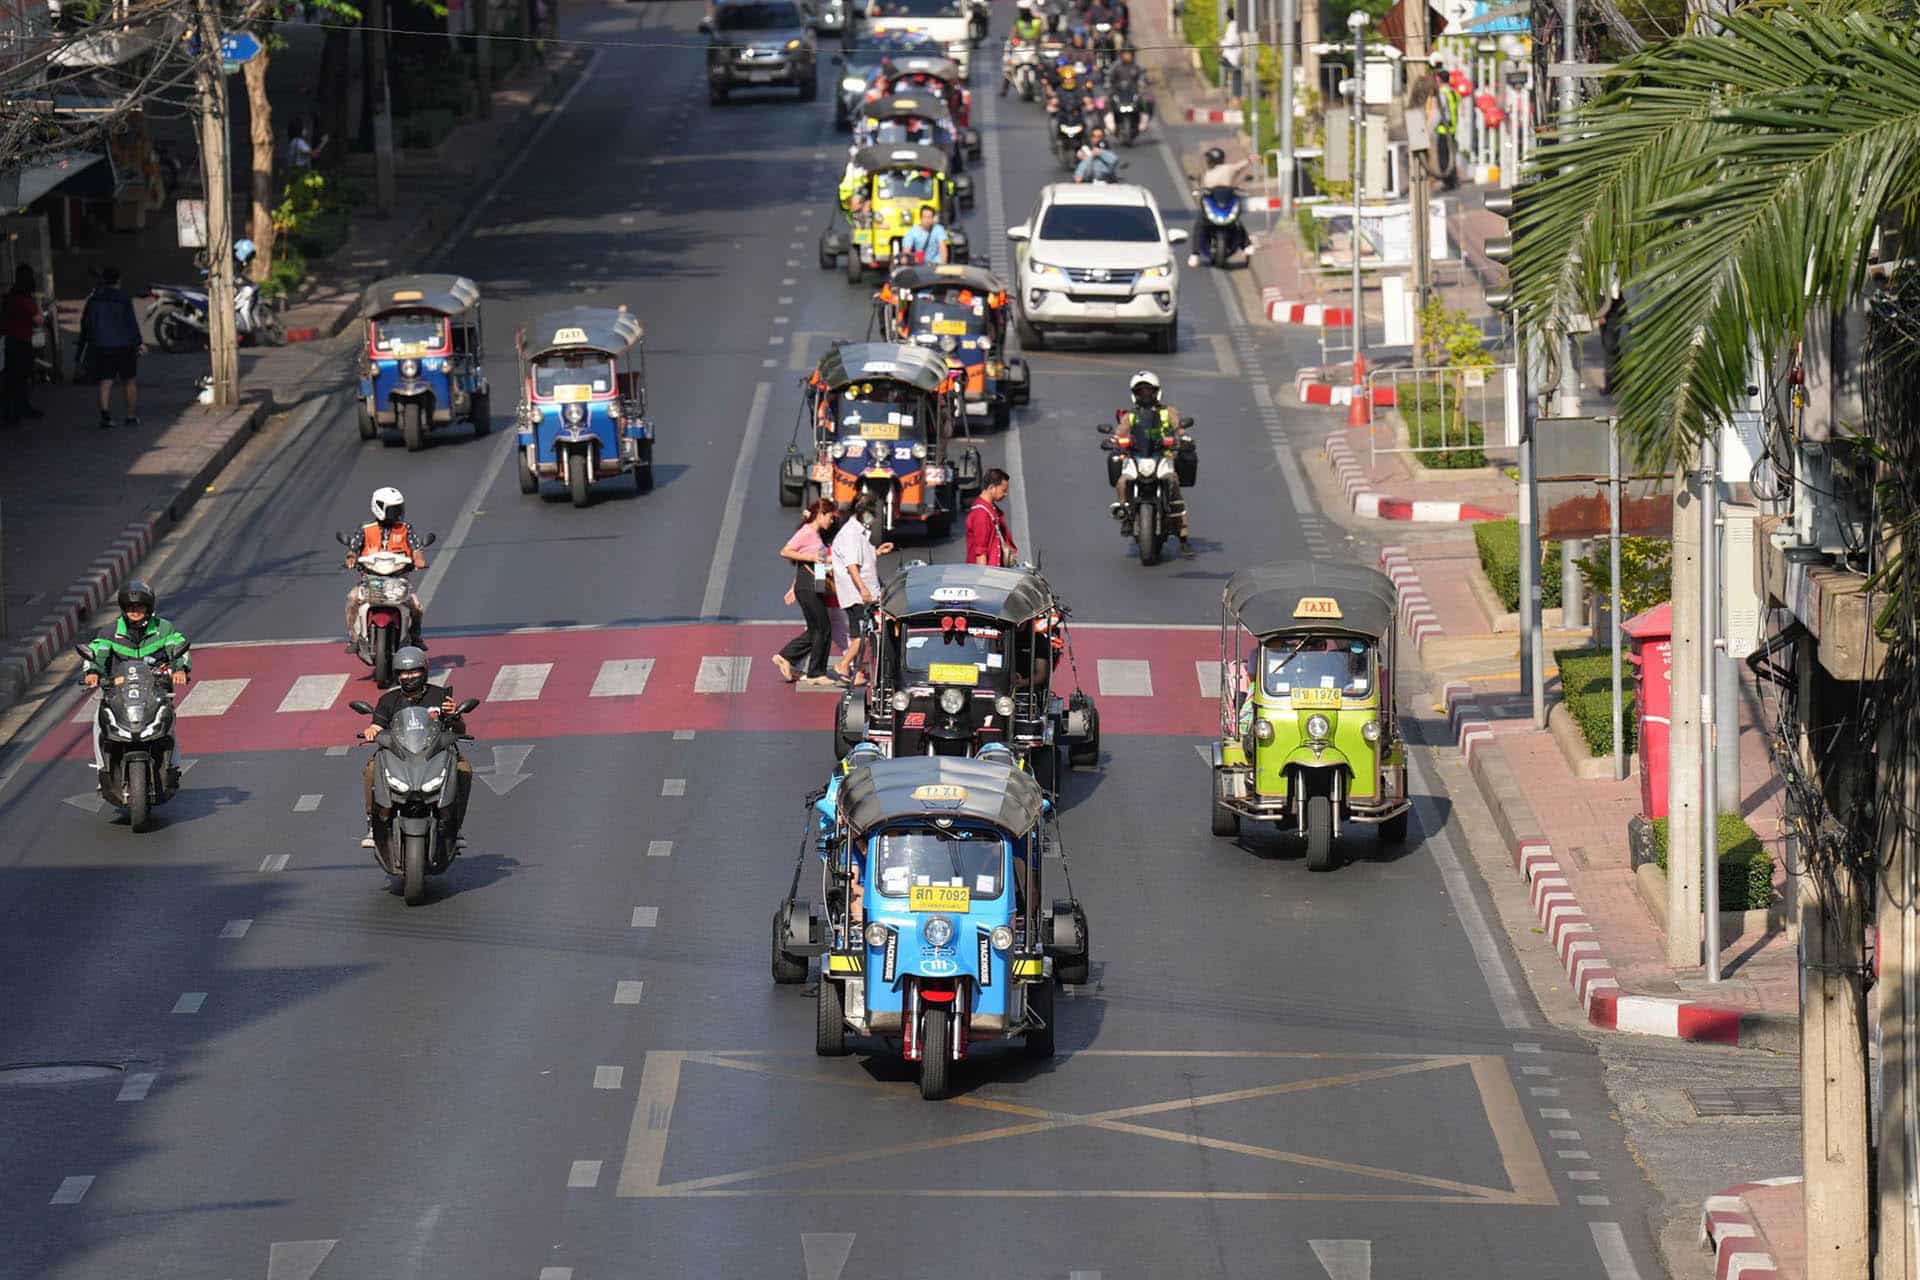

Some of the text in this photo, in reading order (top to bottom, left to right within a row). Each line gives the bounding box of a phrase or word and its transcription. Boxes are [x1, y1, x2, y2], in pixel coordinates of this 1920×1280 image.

[895, 448, 911, 459] 23
[943, 589, 969, 597] TAXI
[1303, 601, 1333, 612] TAXI
[983, 715, 993, 727] 1
[939, 889, 967, 901] 7092
